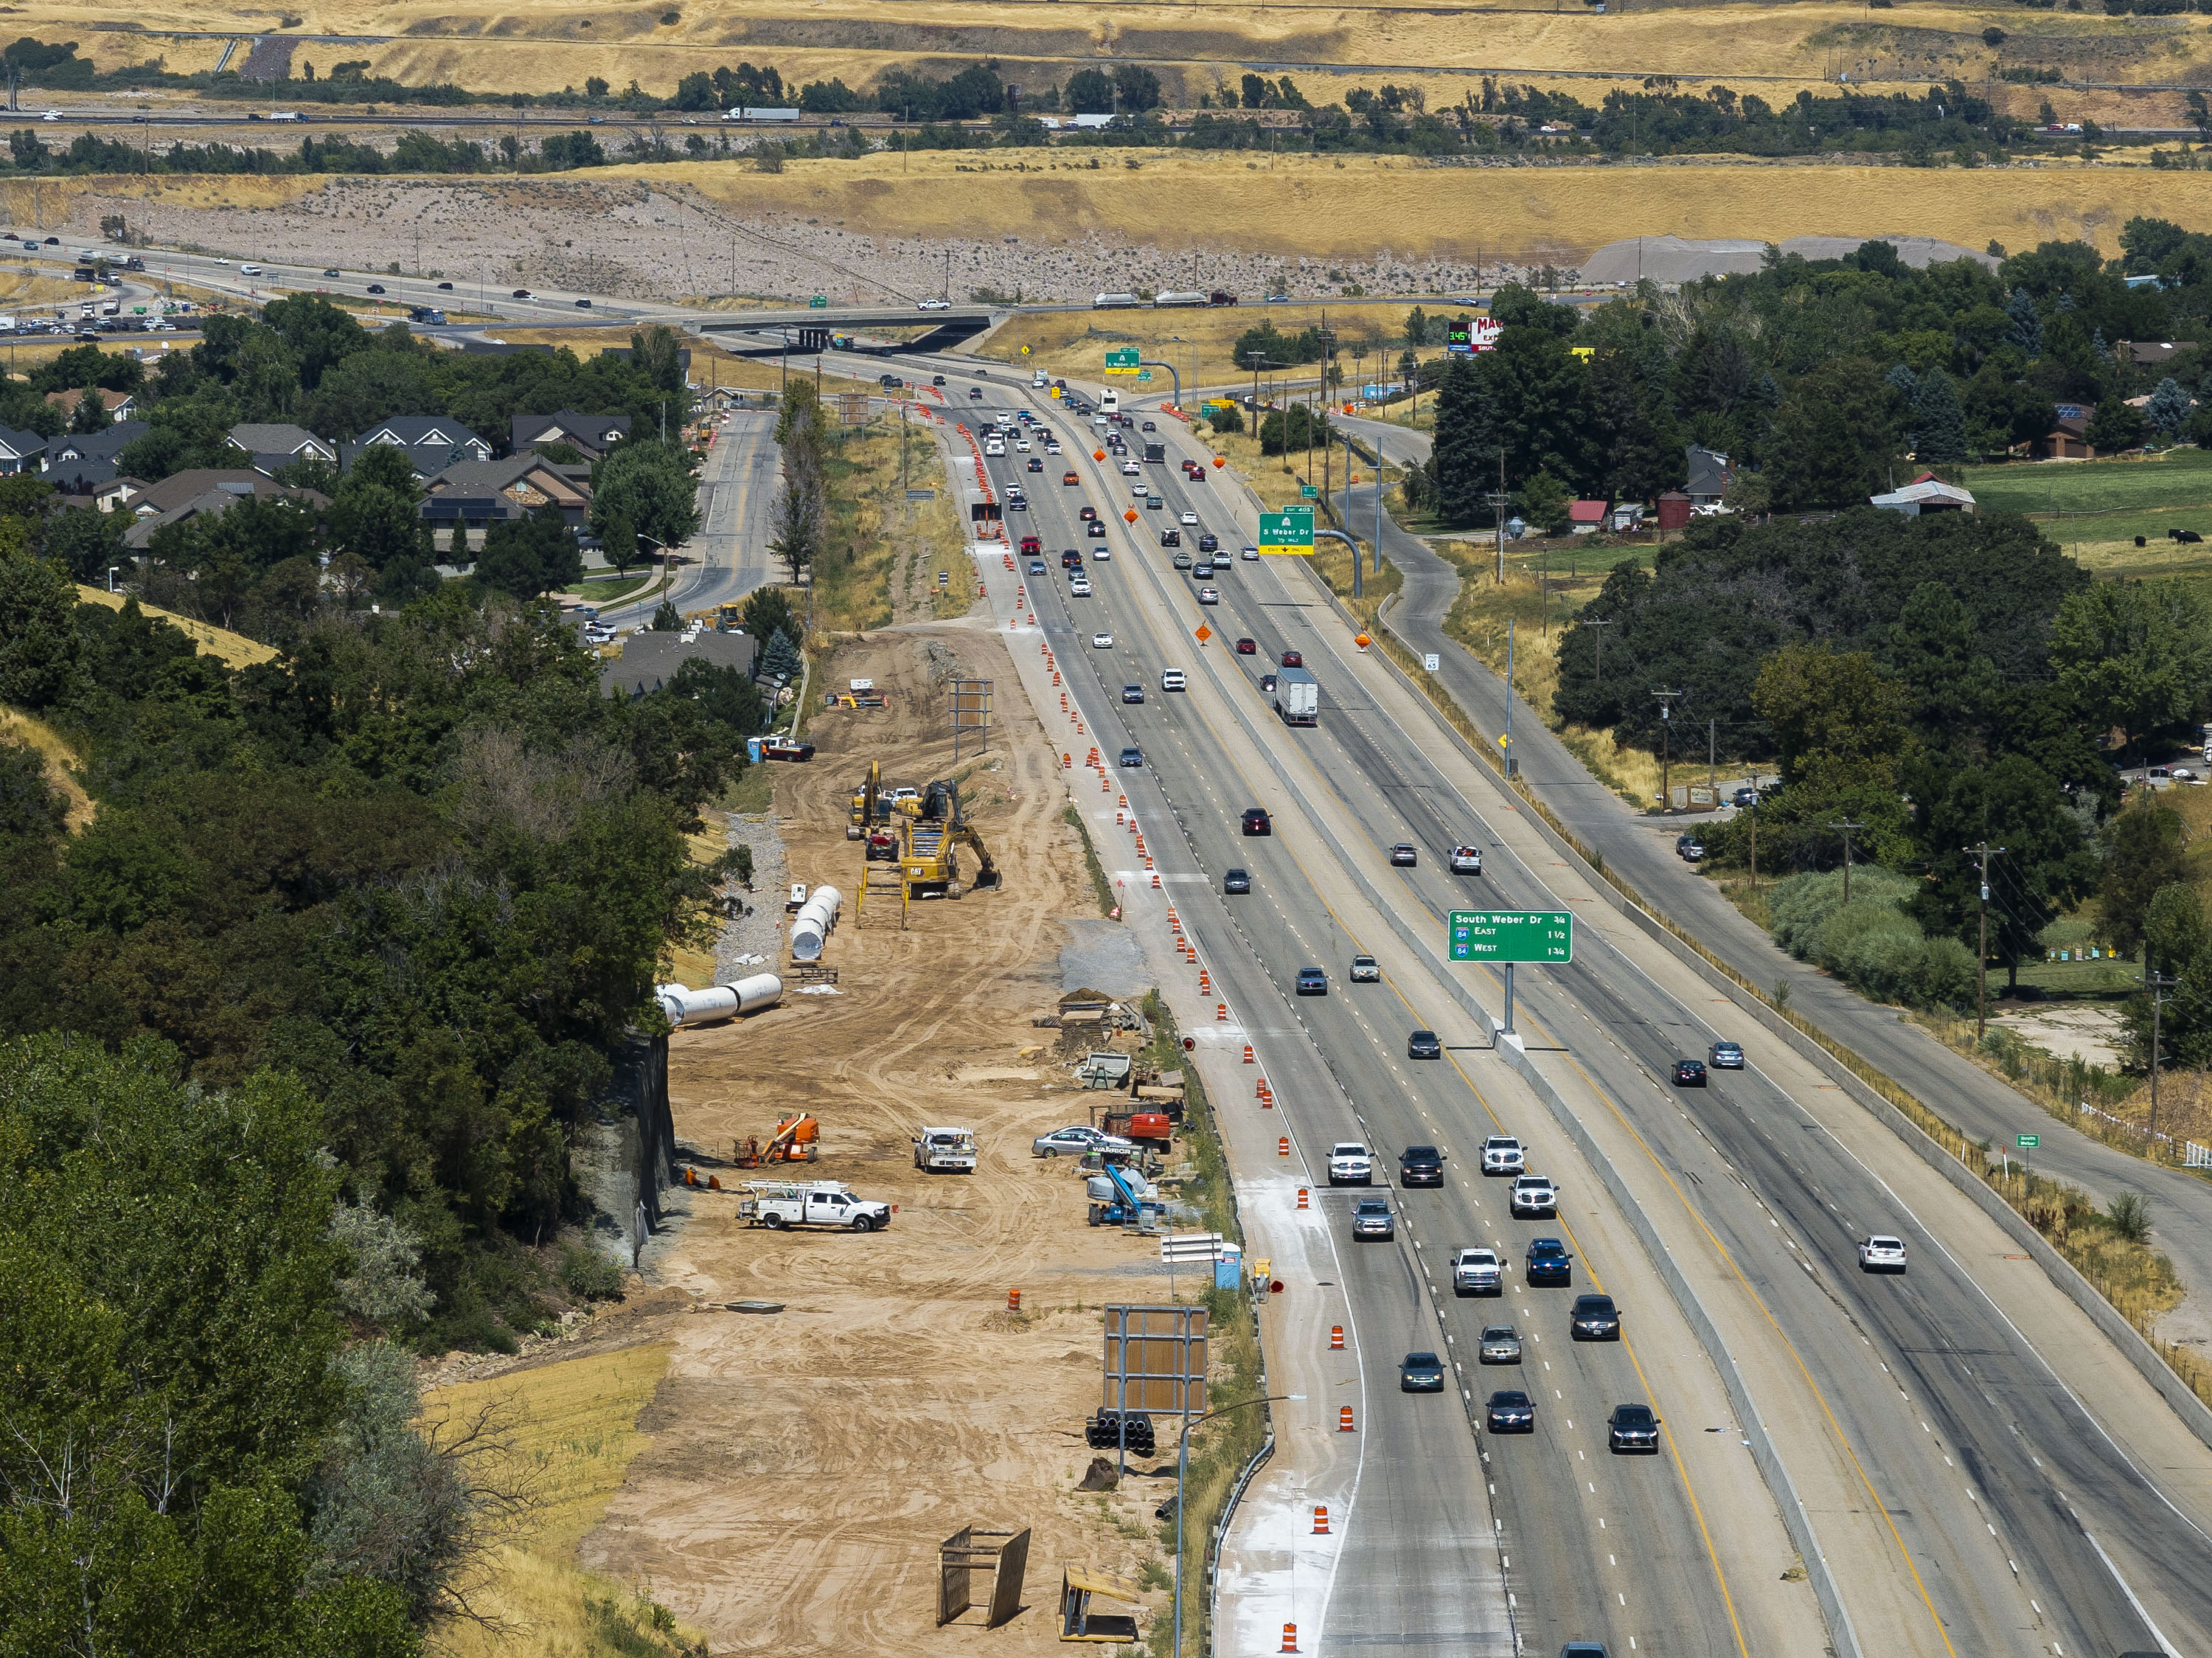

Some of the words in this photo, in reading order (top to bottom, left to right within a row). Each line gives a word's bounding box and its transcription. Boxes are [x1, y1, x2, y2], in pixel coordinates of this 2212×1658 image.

[911, 867, 922, 875] CAT
[1455, 915, 1486, 923] South
[1492, 915, 1524, 923] Weber
[1093, 1146, 1130, 1154] WARRIOR
